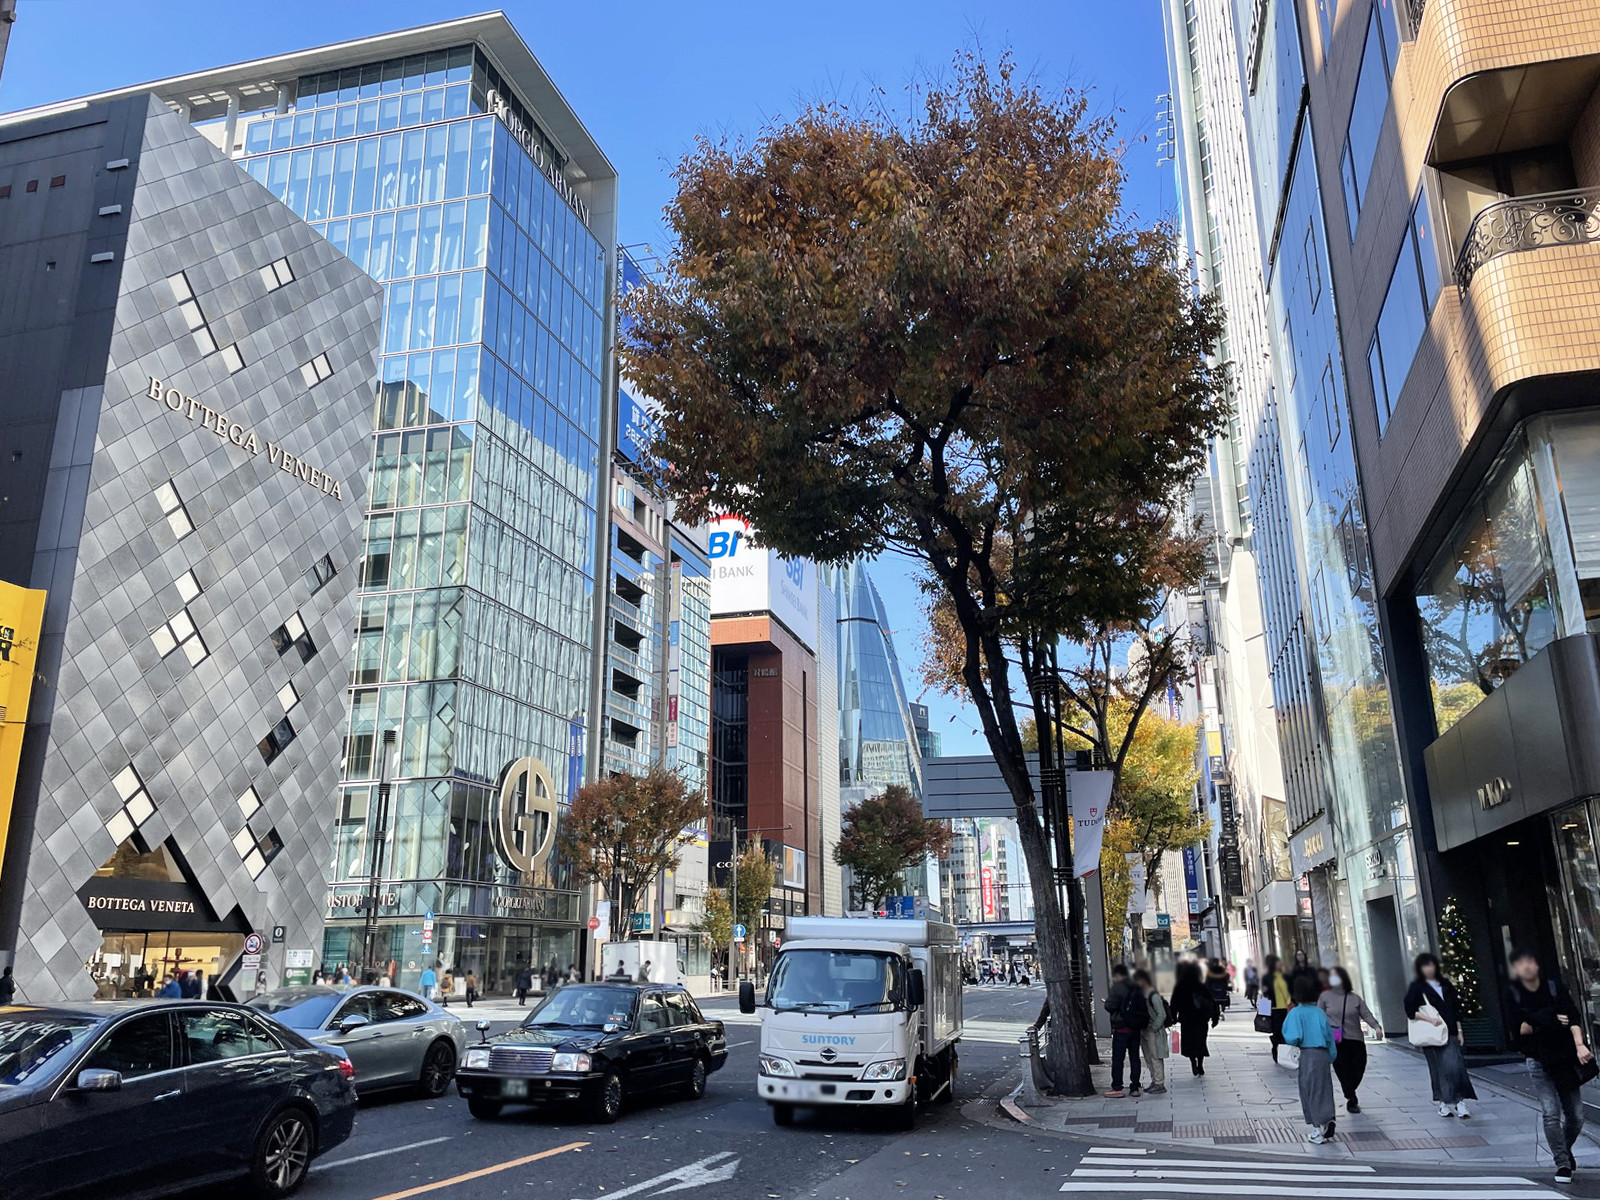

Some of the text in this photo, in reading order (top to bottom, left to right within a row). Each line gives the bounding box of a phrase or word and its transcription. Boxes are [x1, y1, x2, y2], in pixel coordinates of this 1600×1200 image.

[546, 164, 590, 227] ARMANI
[146, 376, 343, 501] BOTTEGA VENETA
[707, 531, 741, 559] BI
[719, 565, 754, 579] BANK
[87, 895, 196, 914] BOTTEGA VENETA
